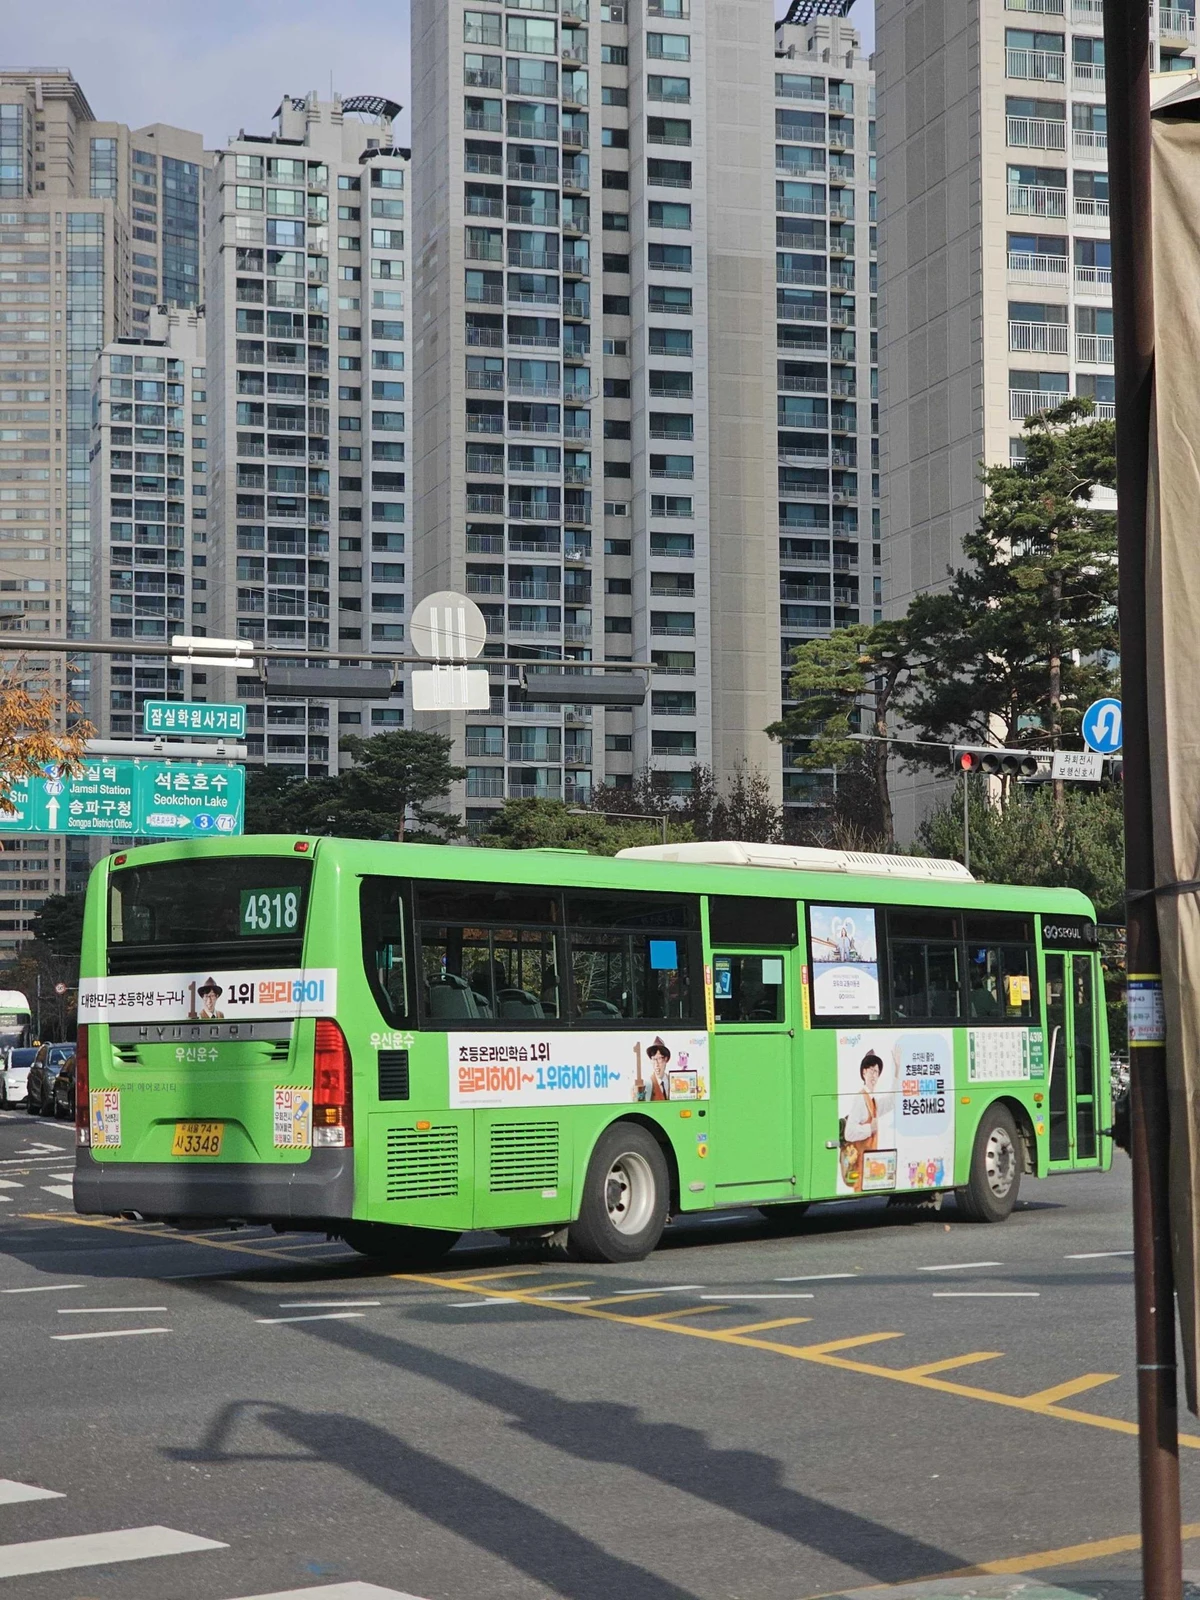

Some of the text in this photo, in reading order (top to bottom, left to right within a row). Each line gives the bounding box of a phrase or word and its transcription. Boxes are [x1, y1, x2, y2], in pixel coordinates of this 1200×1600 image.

[151, 708, 240, 730] 잠실학원사거리
[1059, 767, 1095, 778] 보행신호시
[49, 783, 60, 793] 71
[70, 784, 131, 795] Jamsil Station
[155, 772, 228, 792] 석촌호수
[10, 791, 28, 803] Stn
[154, 793, 228, 807] Seokchon Lake
[69, 799, 131, 816] 송파구청
[68, 817, 132, 829] Songpa District Office
[200, 816, 208, 828] 3
[220, 817, 232, 829] 71
[245, 892, 298, 929] 4318
[81, 993, 116, 1008] 대한민국
[118, 991, 154, 1007] 초등학생
[156, 990, 184, 1006] 누구나
[228, 983, 254, 1004] 1위
[259, 980, 324, 1004] 엘리하이
[370, 1032, 414, 1050] 우신운수
[175, 1047, 218, 1062] 우신운수
[459, 1042, 550, 1062] 초등온라인학습 1위
[458, 1064, 621, 1092] 엘리하이~ 1위하이 해~
[906, 1064, 928, 1076] 초등학교
[104, 1093, 118, 1111] 주의
[275, 1091, 292, 1110] 주의
[903, 1098, 945, 1116] 환승하세요
